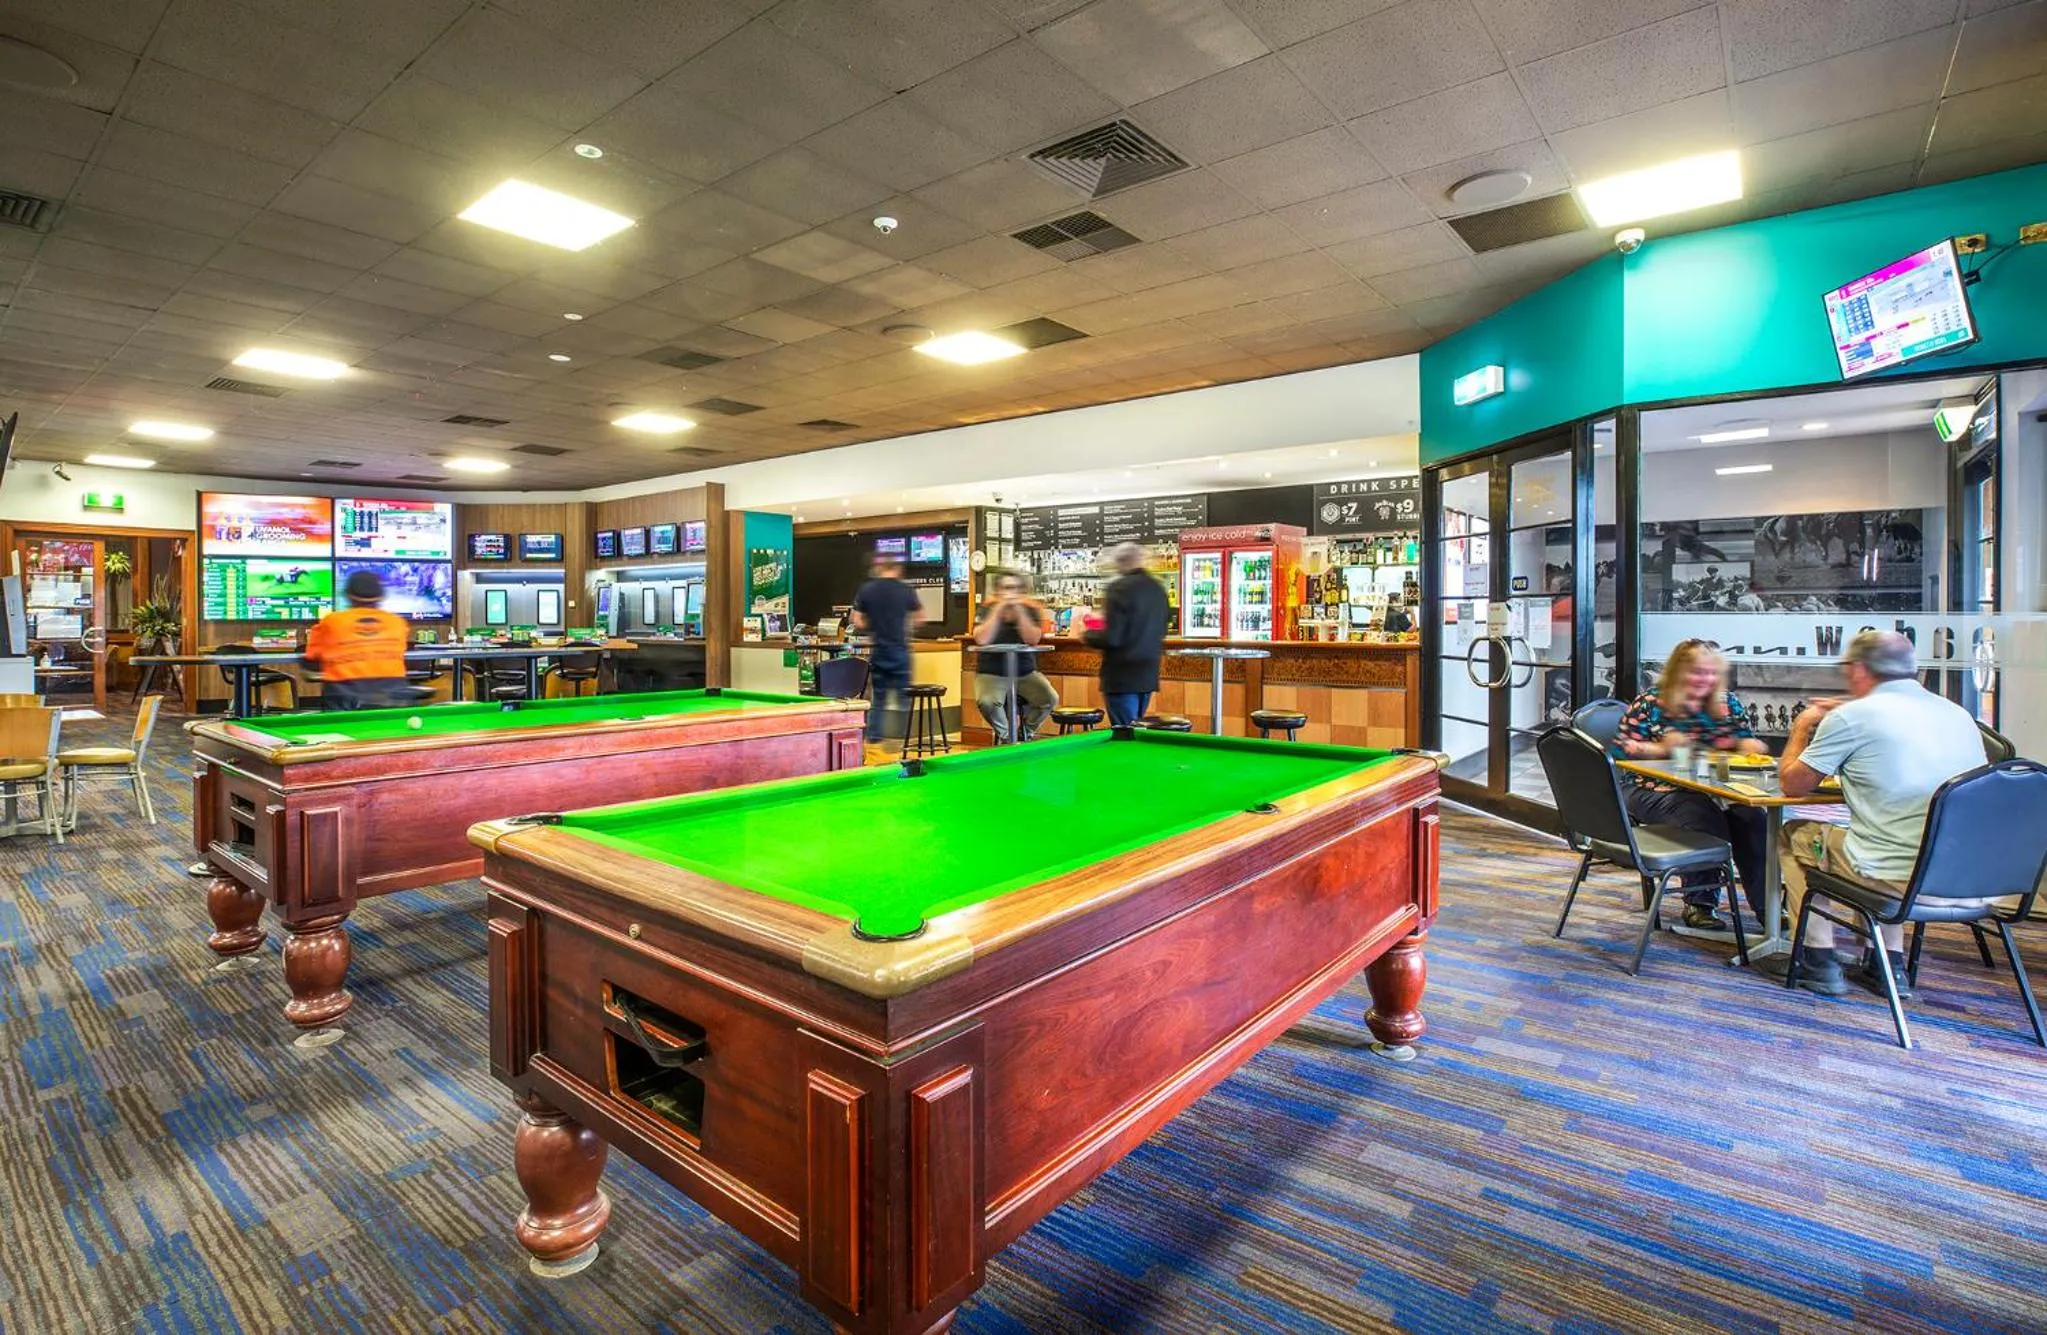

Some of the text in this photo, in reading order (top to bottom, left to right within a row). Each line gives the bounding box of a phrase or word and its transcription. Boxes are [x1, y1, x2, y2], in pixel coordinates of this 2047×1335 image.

[1330, 479, 1420, 494] DRINK SPE
[1341, 502, 1358, 516] $7
[1395, 499, 1415, 513] $9
[1181, 533, 1206, 543] enjoy
[1208, 531, 1223, 541] ice
[1224, 529, 1246, 540] cold
